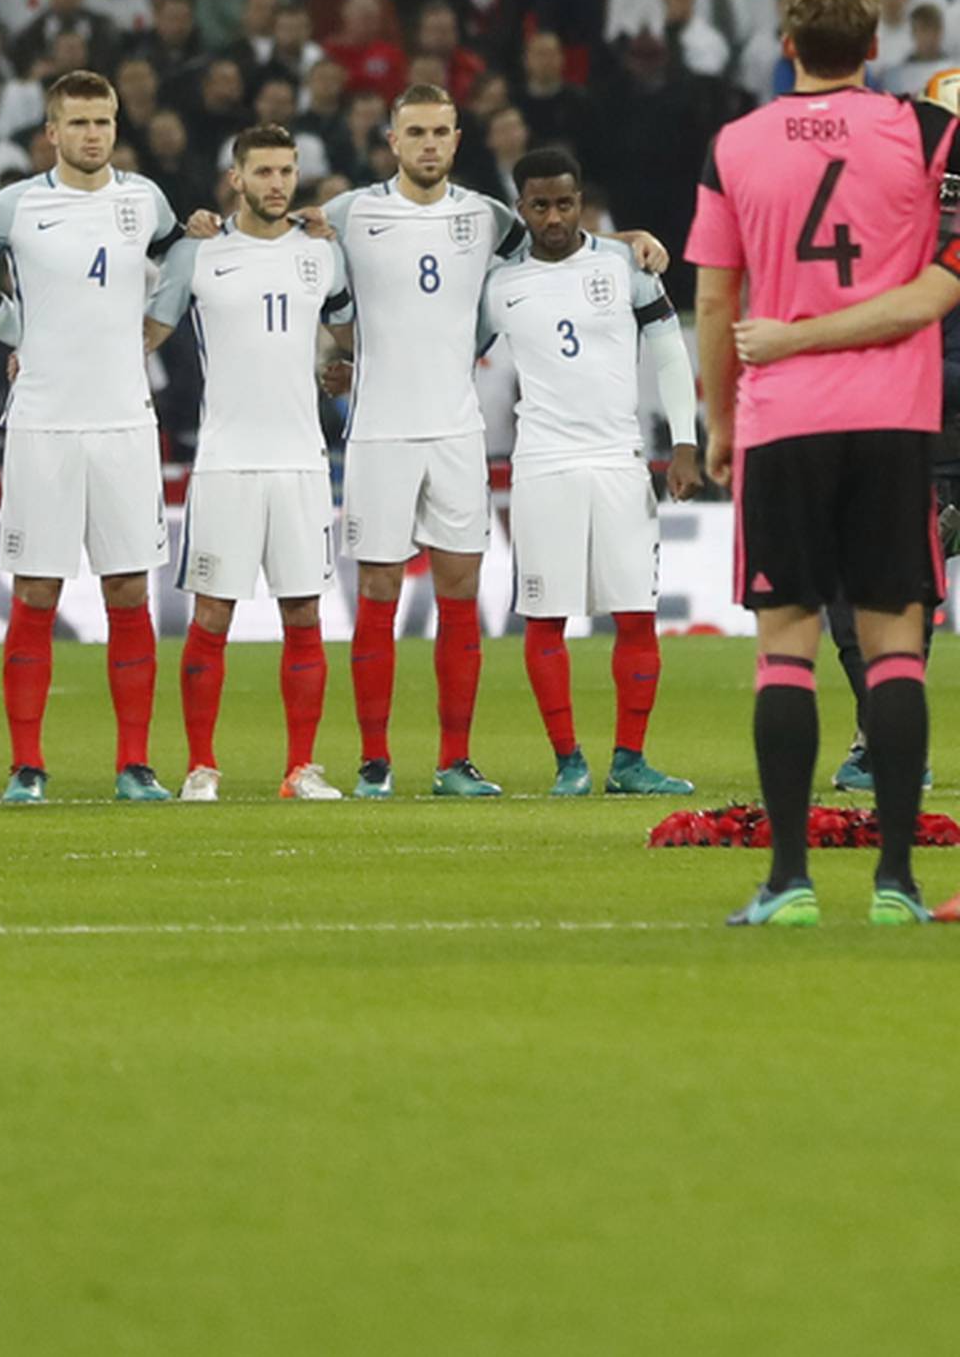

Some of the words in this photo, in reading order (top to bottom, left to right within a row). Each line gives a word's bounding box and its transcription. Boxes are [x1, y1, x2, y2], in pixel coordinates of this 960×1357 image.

[785, 116, 850, 142] BERRA
[795, 157, 863, 289] 4
[87, 246, 107, 288] 4
[418, 254, 441, 294] 8
[262, 292, 288, 333] 11
[556, 319, 580, 358] 3
